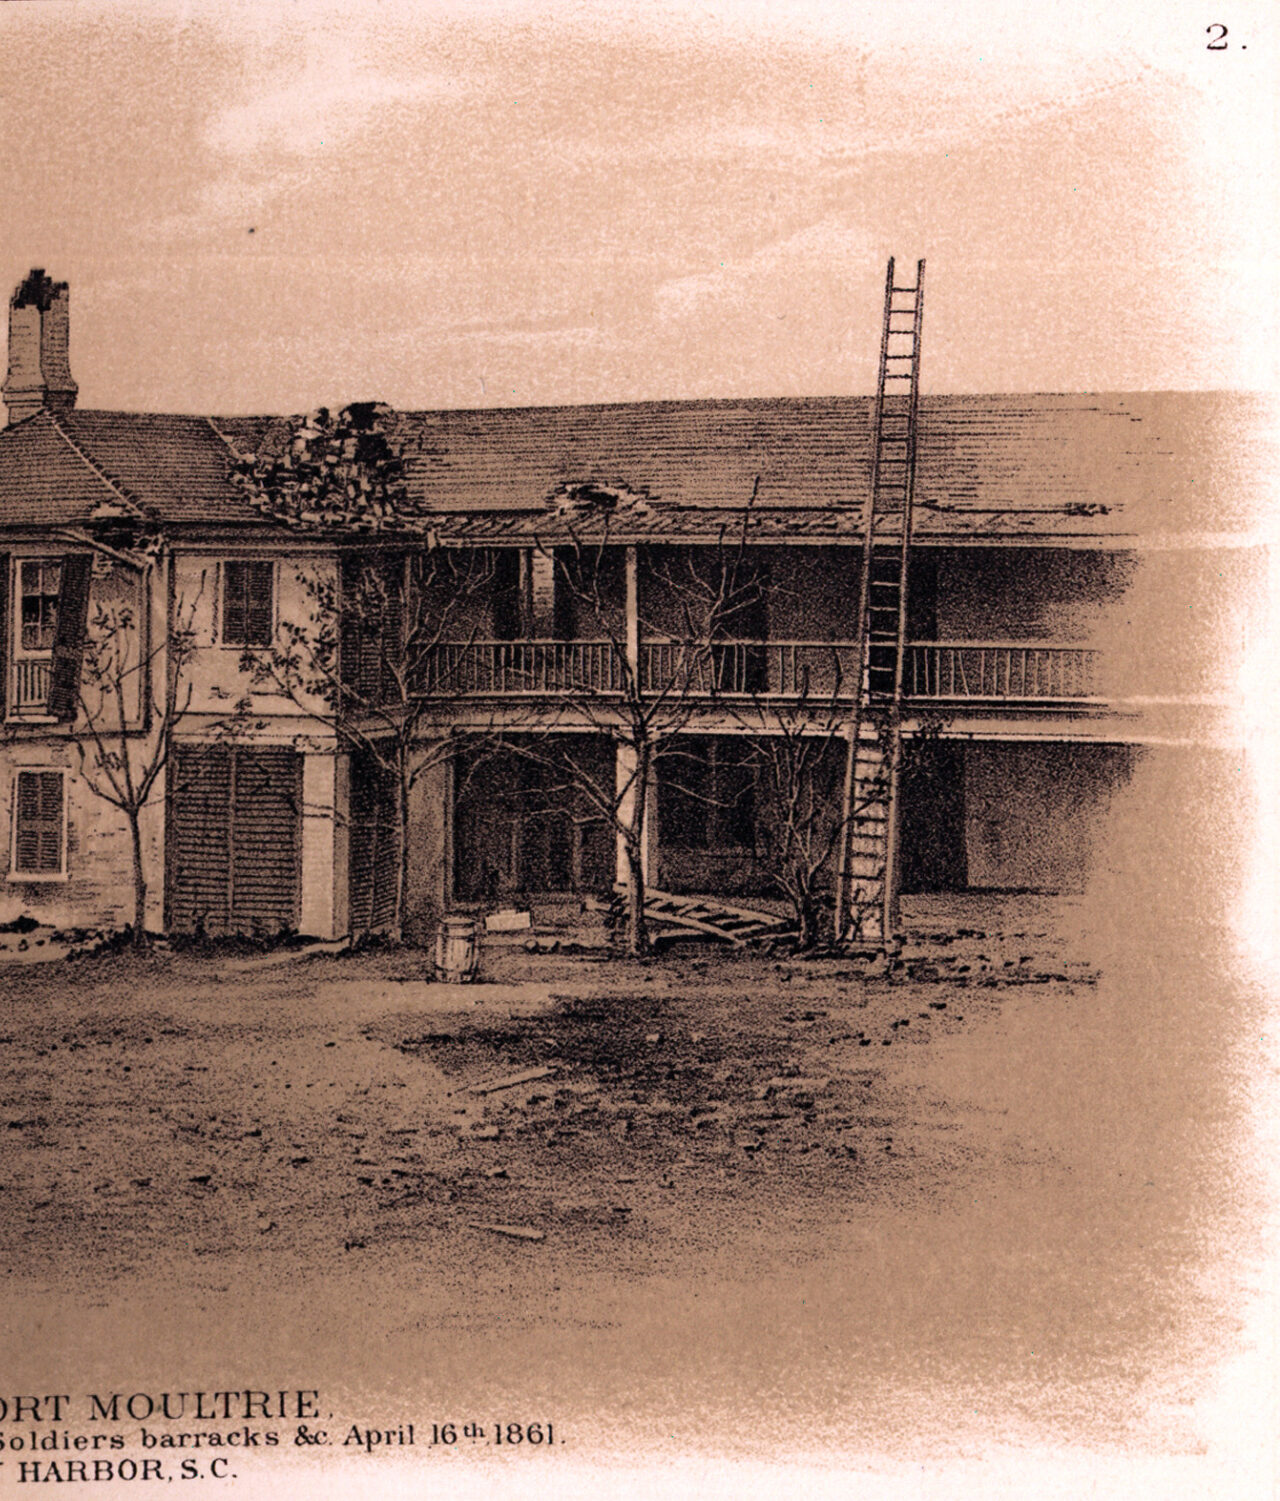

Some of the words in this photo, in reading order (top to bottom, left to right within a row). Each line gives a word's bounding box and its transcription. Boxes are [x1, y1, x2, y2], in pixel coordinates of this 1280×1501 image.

[140, 1426, 280, 1449] barracks
[342, 1423, 416, 1453] April
[494, 1422, 566, 1446] 1861.
[17, 1458, 174, 1483] HARBOR,
